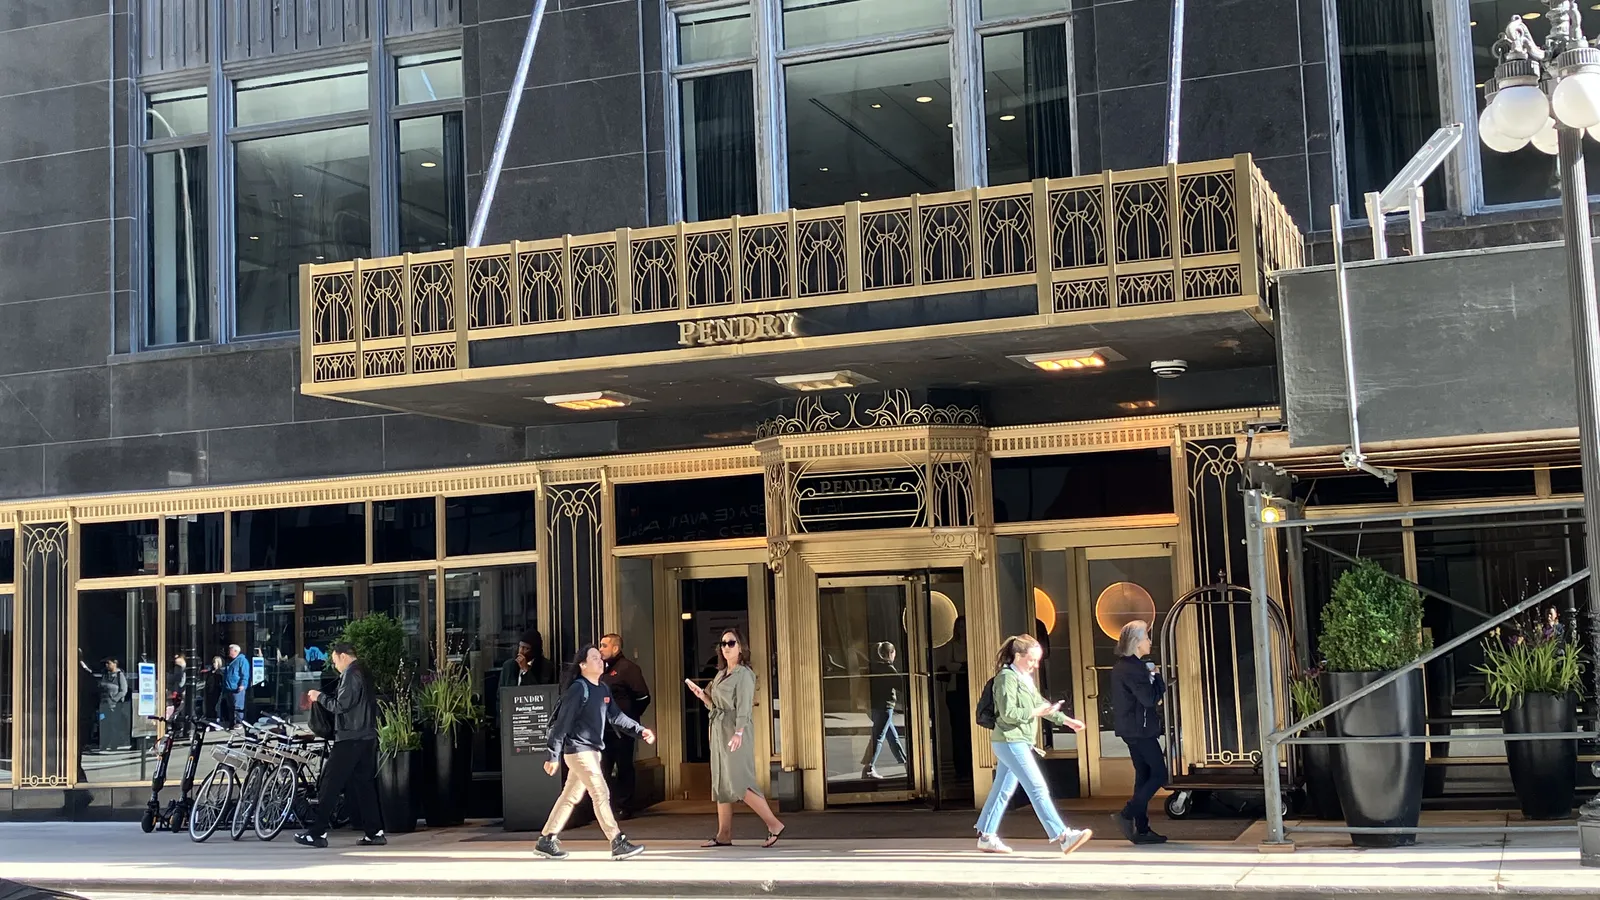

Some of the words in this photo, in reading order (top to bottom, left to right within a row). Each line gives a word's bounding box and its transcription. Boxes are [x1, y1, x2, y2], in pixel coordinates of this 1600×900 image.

[678, 312, 798, 344] PENDRY
[820, 477, 896, 494] PENDRY
[514, 695, 544, 704] PENDRY
